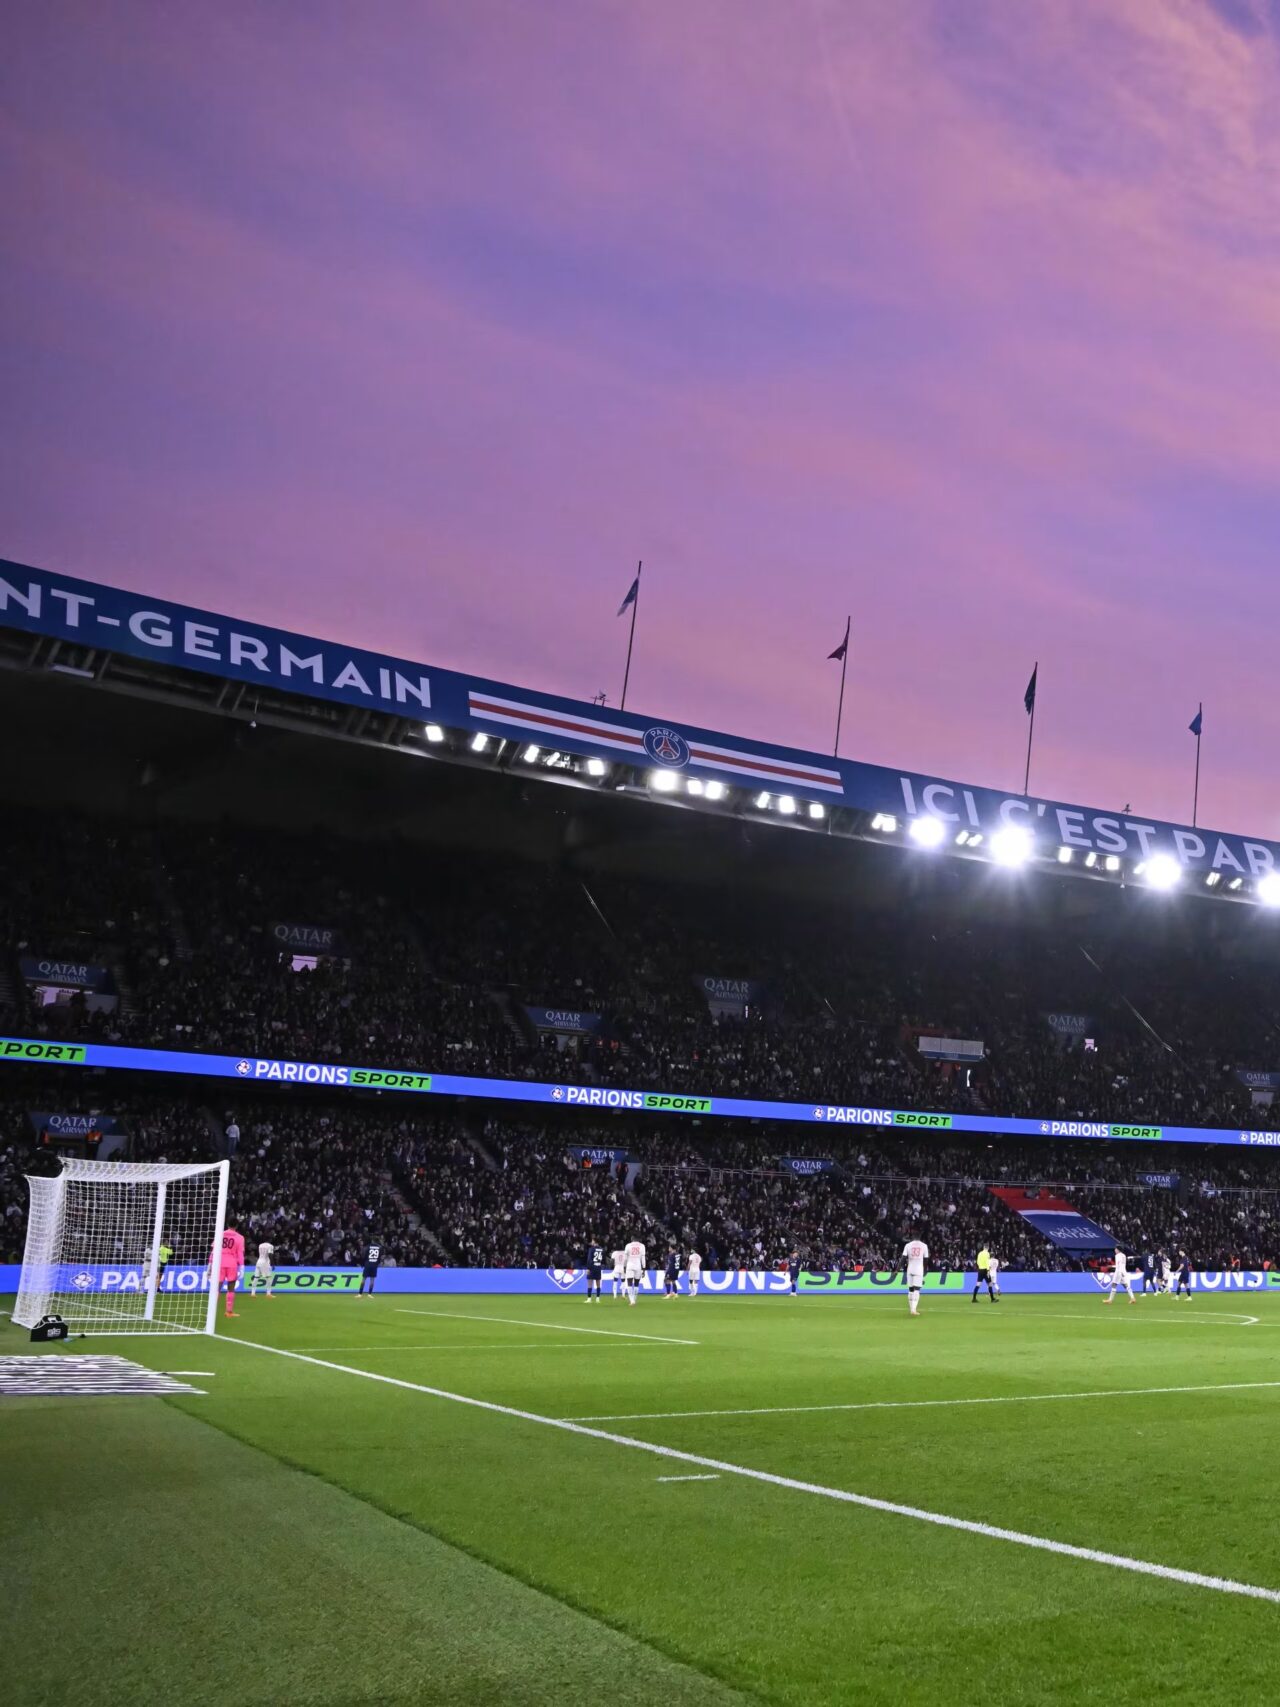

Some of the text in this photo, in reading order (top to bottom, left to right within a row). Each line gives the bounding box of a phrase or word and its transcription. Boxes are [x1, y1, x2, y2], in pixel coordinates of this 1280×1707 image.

[650, 730, 679, 742] PARIS
[900, 777, 980, 827] ICI
[274, 924, 332, 944] QATAR
[38, 961, 88, 977] QATAR
[704, 978, 749, 994] QATAR
[545, 1010, 580, 1022] QATAR
[1048, 1014, 1086, 1028] QATAR
[0, 1041, 83, 1060] PORT
[255, 1061, 429, 1088] PARIONS SPORT
[1246, 1072, 1271, 1082] QATAR
[567, 1087, 709, 1110] PARIONS SPORT
[49, 1115, 97, 1128] QATAR
[827, 1107, 950, 1126] PARIONS SPORT
[1051, 1122, 1160, 1137] PARIONS SPORT
[581, 1149, 615, 1160] QATAR
[792, 1160, 822, 1170] QATAR
[1146, 1174, 1171, 1184] QATAR
[369, 1249, 379, 1259] 29
[593, 1251, 603, 1262] 24
